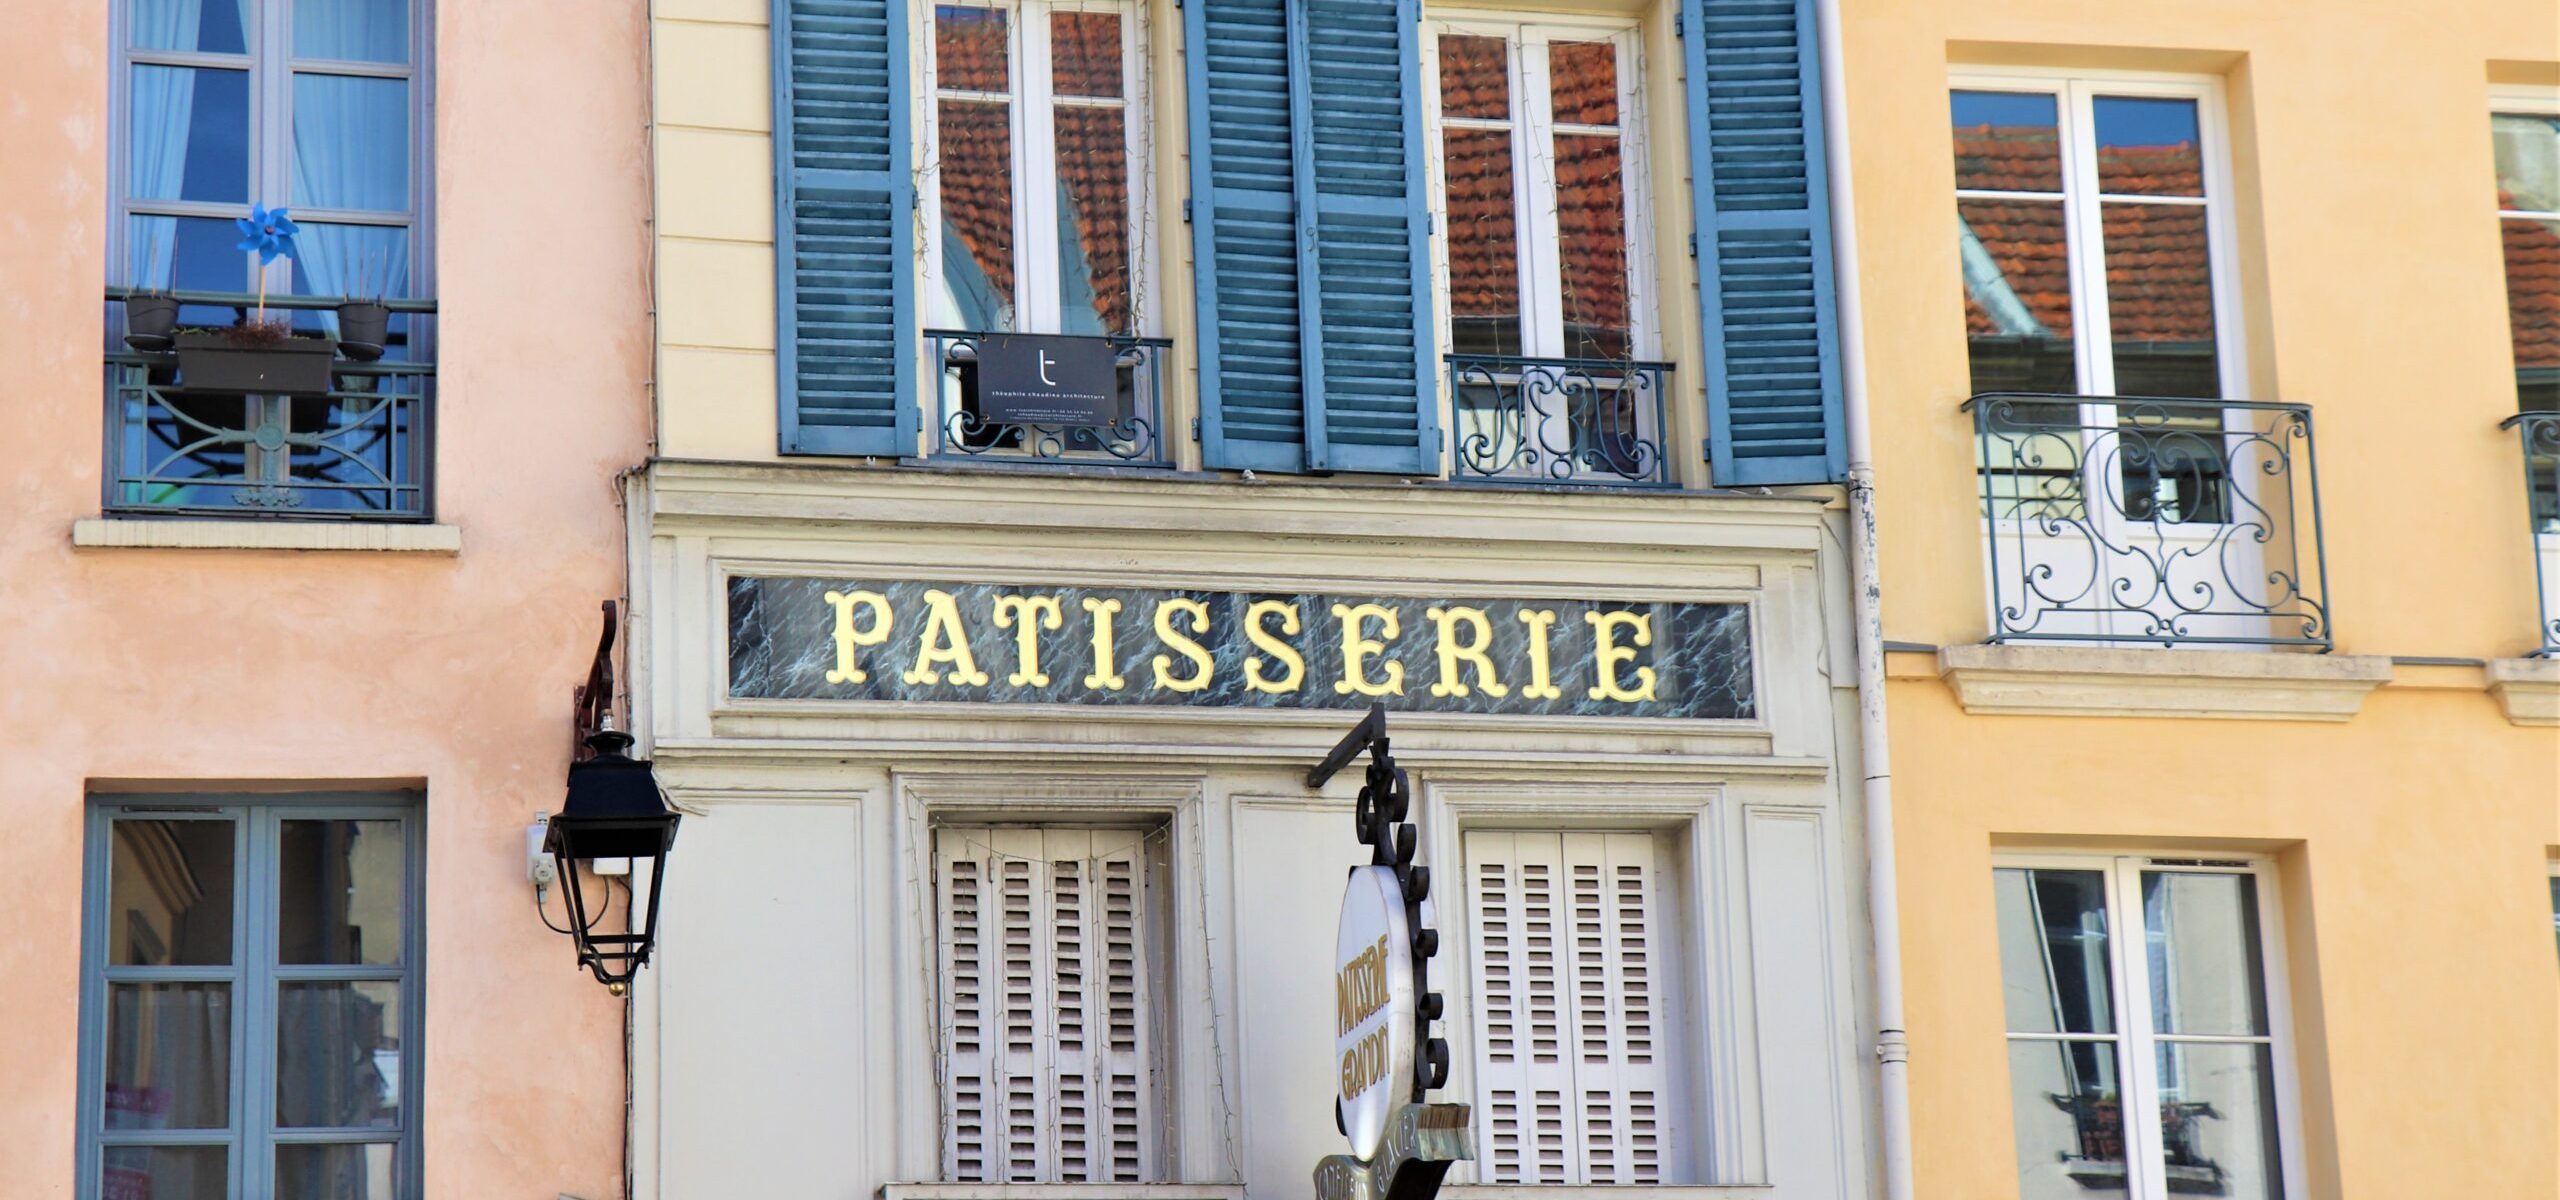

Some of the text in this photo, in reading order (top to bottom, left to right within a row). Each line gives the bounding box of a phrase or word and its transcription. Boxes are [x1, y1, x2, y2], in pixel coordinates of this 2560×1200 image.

[823, 589, 1658, 703] PATISSERIE
[1336, 934, 1390, 1038] PATISSERIE
[1341, 1022, 1390, 1101] GRANDIN
[1377, 1111, 1416, 1193] GLACIER
